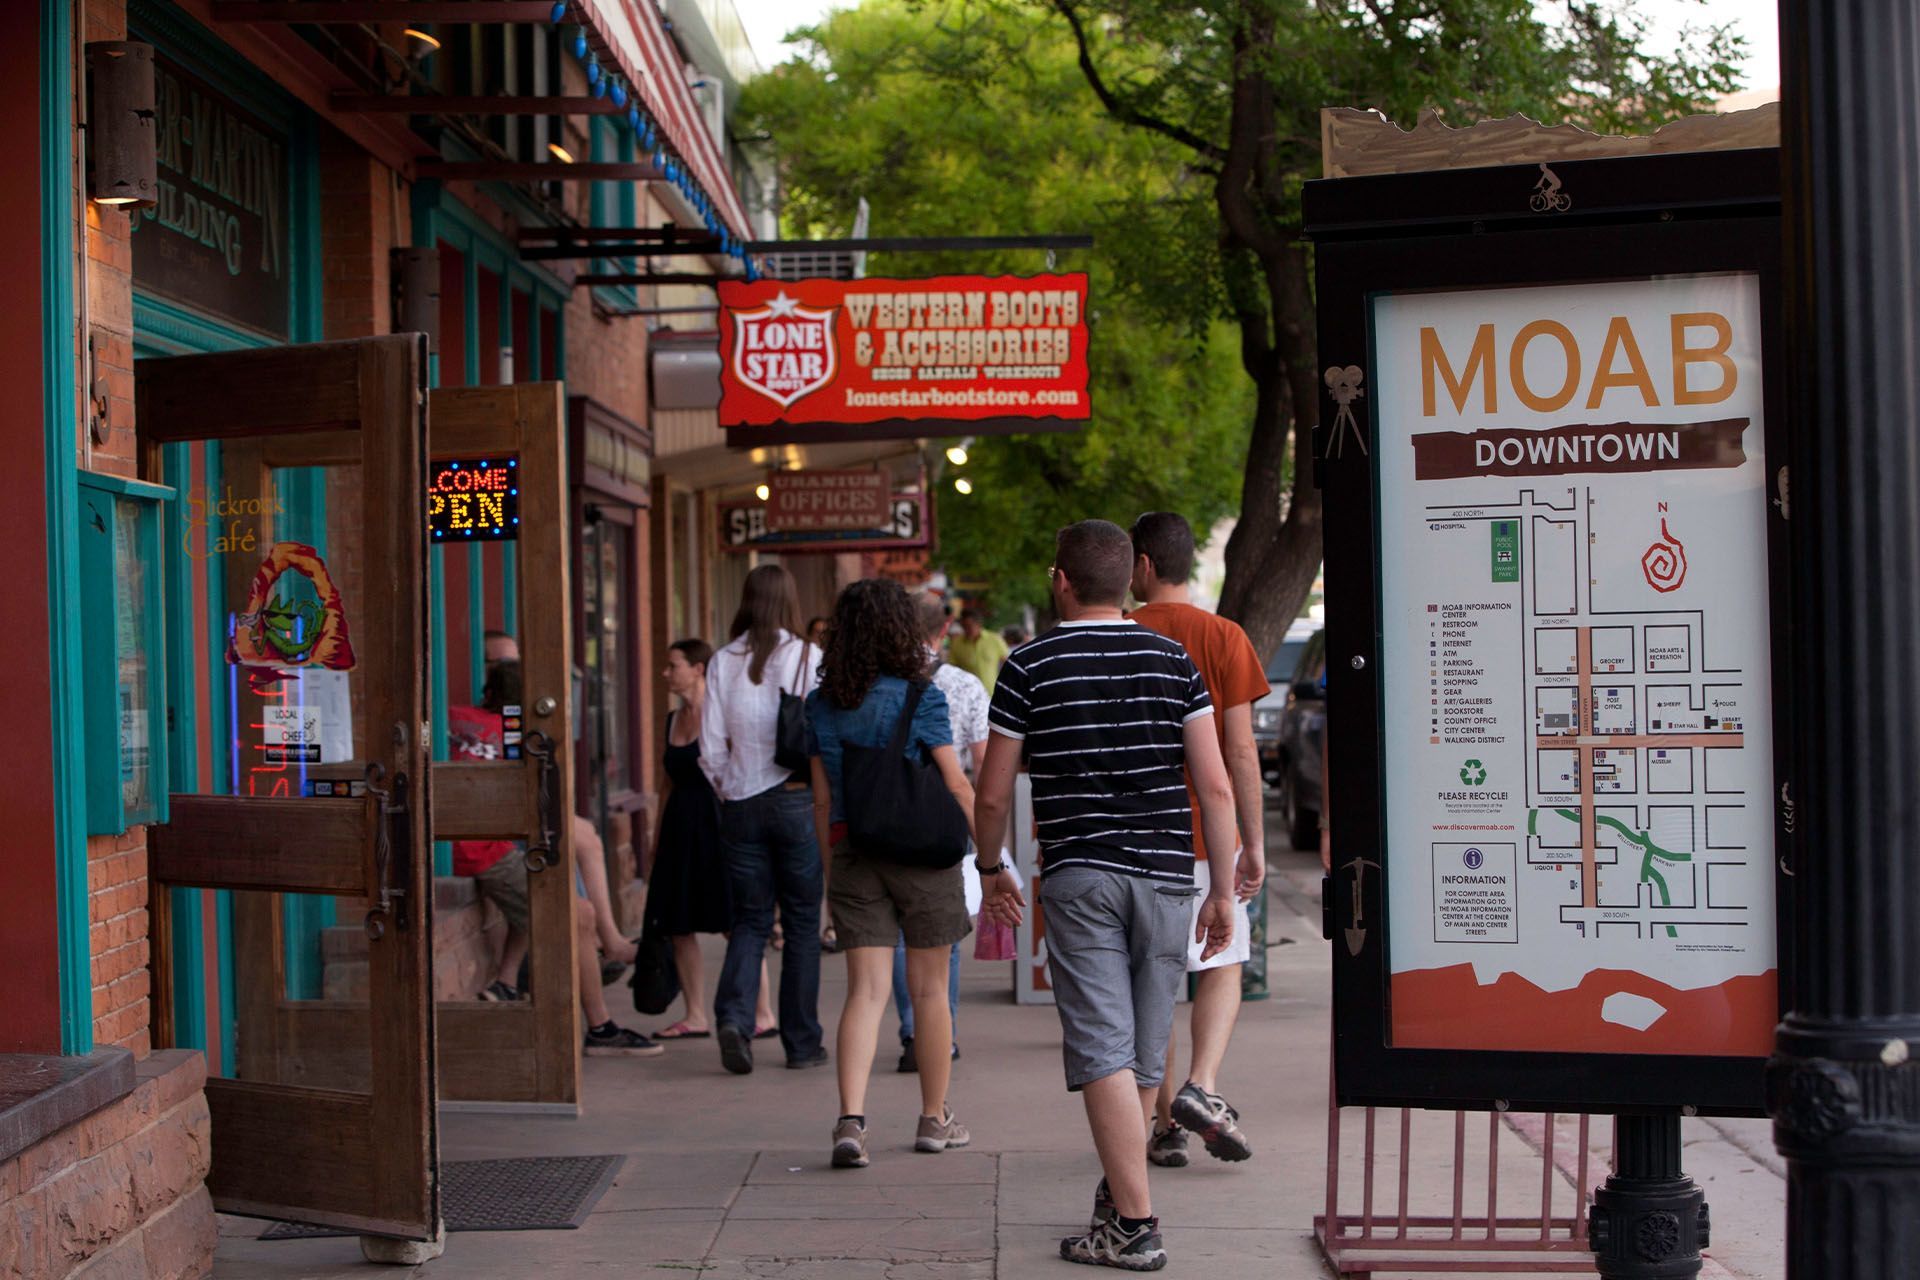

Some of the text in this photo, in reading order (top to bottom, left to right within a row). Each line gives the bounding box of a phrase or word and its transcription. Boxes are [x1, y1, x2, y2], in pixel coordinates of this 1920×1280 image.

[844, 290, 1079, 329] WESTERN BOOTS
[746, 322, 823, 350] LONE
[855, 328, 1070, 367] & ACCESSORIES
[746, 353, 823, 379] STAR
[917, 366, 978, 380] SANDALS
[983, 366, 1061, 379] WORKBOOTS
[1420, 311, 1738, 417] MOAB
[846, 387, 1078, 406] lonestarbootstore.com
[1475, 432, 1680, 467] DOWNTOWN
[774, 474, 882, 488] URANIUM
[183, 483, 286, 525] Slickrock
[779, 490, 877, 511] OFFICES
[1657, 502, 1668, 513] N
[822, 513, 882, 525] MAIN
[183, 520, 257, 559] Café
[1442, 603, 1512, 611] MOAB INFORMATION
[1438, 792, 1508, 800] PLEASE RECYCLE!
[1432, 823, 1515, 831] www.discovermoab.com
[1617, 833, 1644, 851] MILLCREEK
[1442, 875, 1506, 885] INFORMATION
